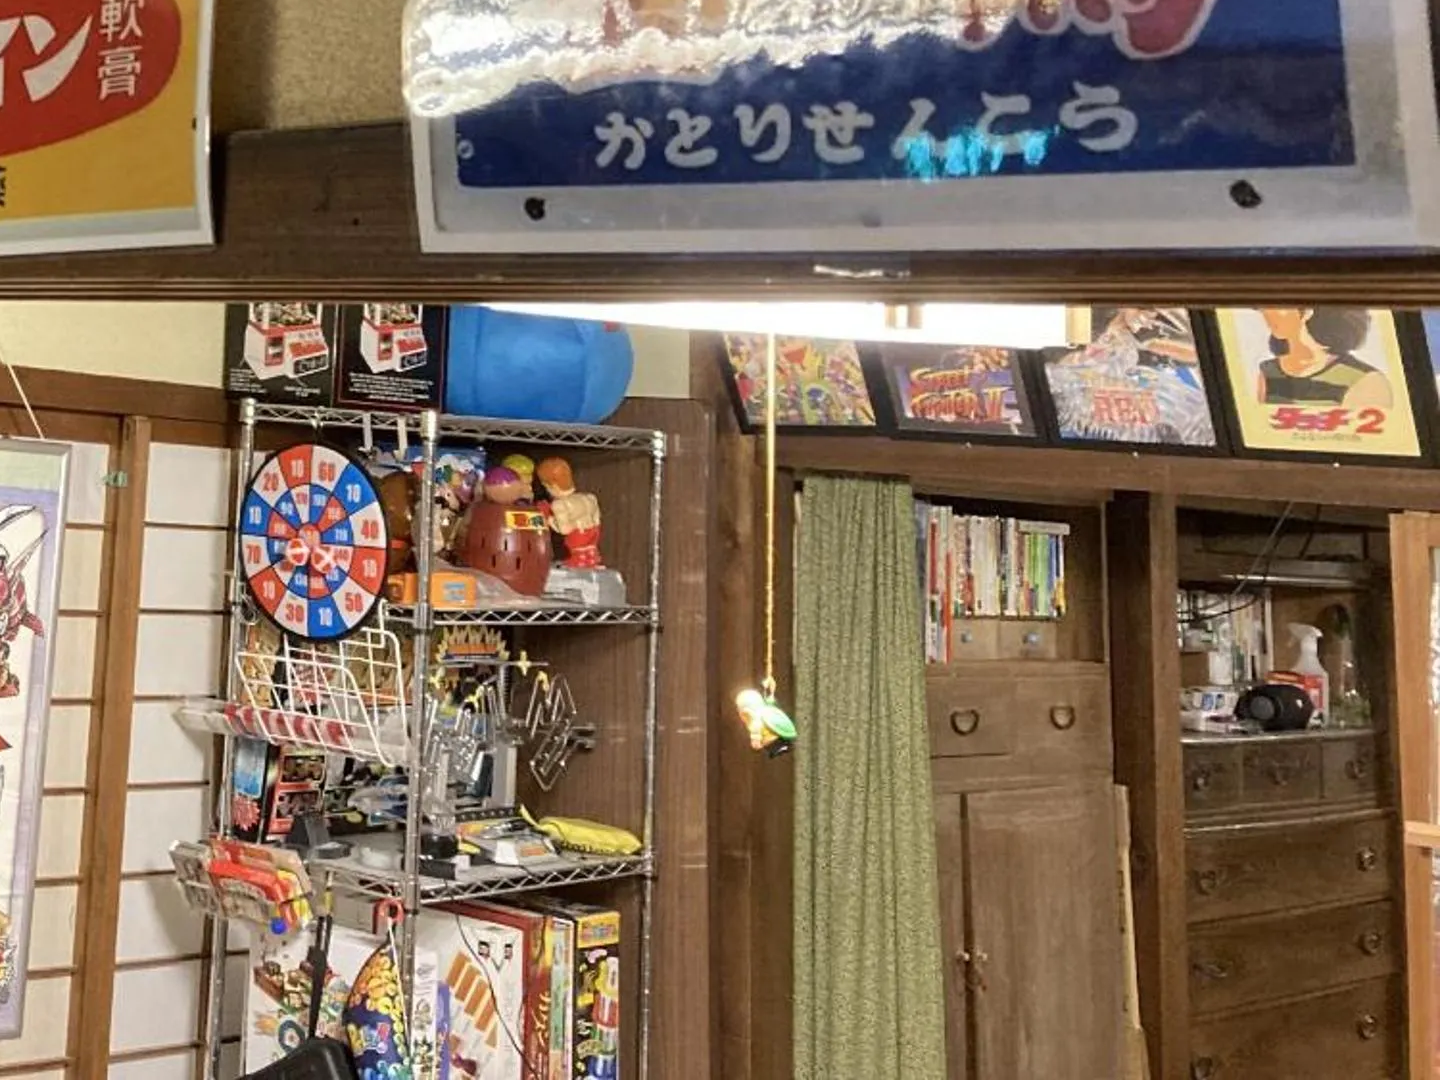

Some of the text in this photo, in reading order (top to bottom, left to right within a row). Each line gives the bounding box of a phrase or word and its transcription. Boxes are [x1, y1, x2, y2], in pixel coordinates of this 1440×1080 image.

[593, 79, 1139, 171] かとりせんこう
[1356, 408, 1386, 434] 2
[345, 483, 361, 502] 10
[248, 506, 262, 524] 10
[360, 520, 379, 540] 40
[245, 545, 260, 565] 70
[362, 559, 377, 577] 10
[262, 579, 276, 599] 10
[344, 592, 364, 613] 50
[285, 603, 305, 623] 30
[318, 607, 333, 627] 10
